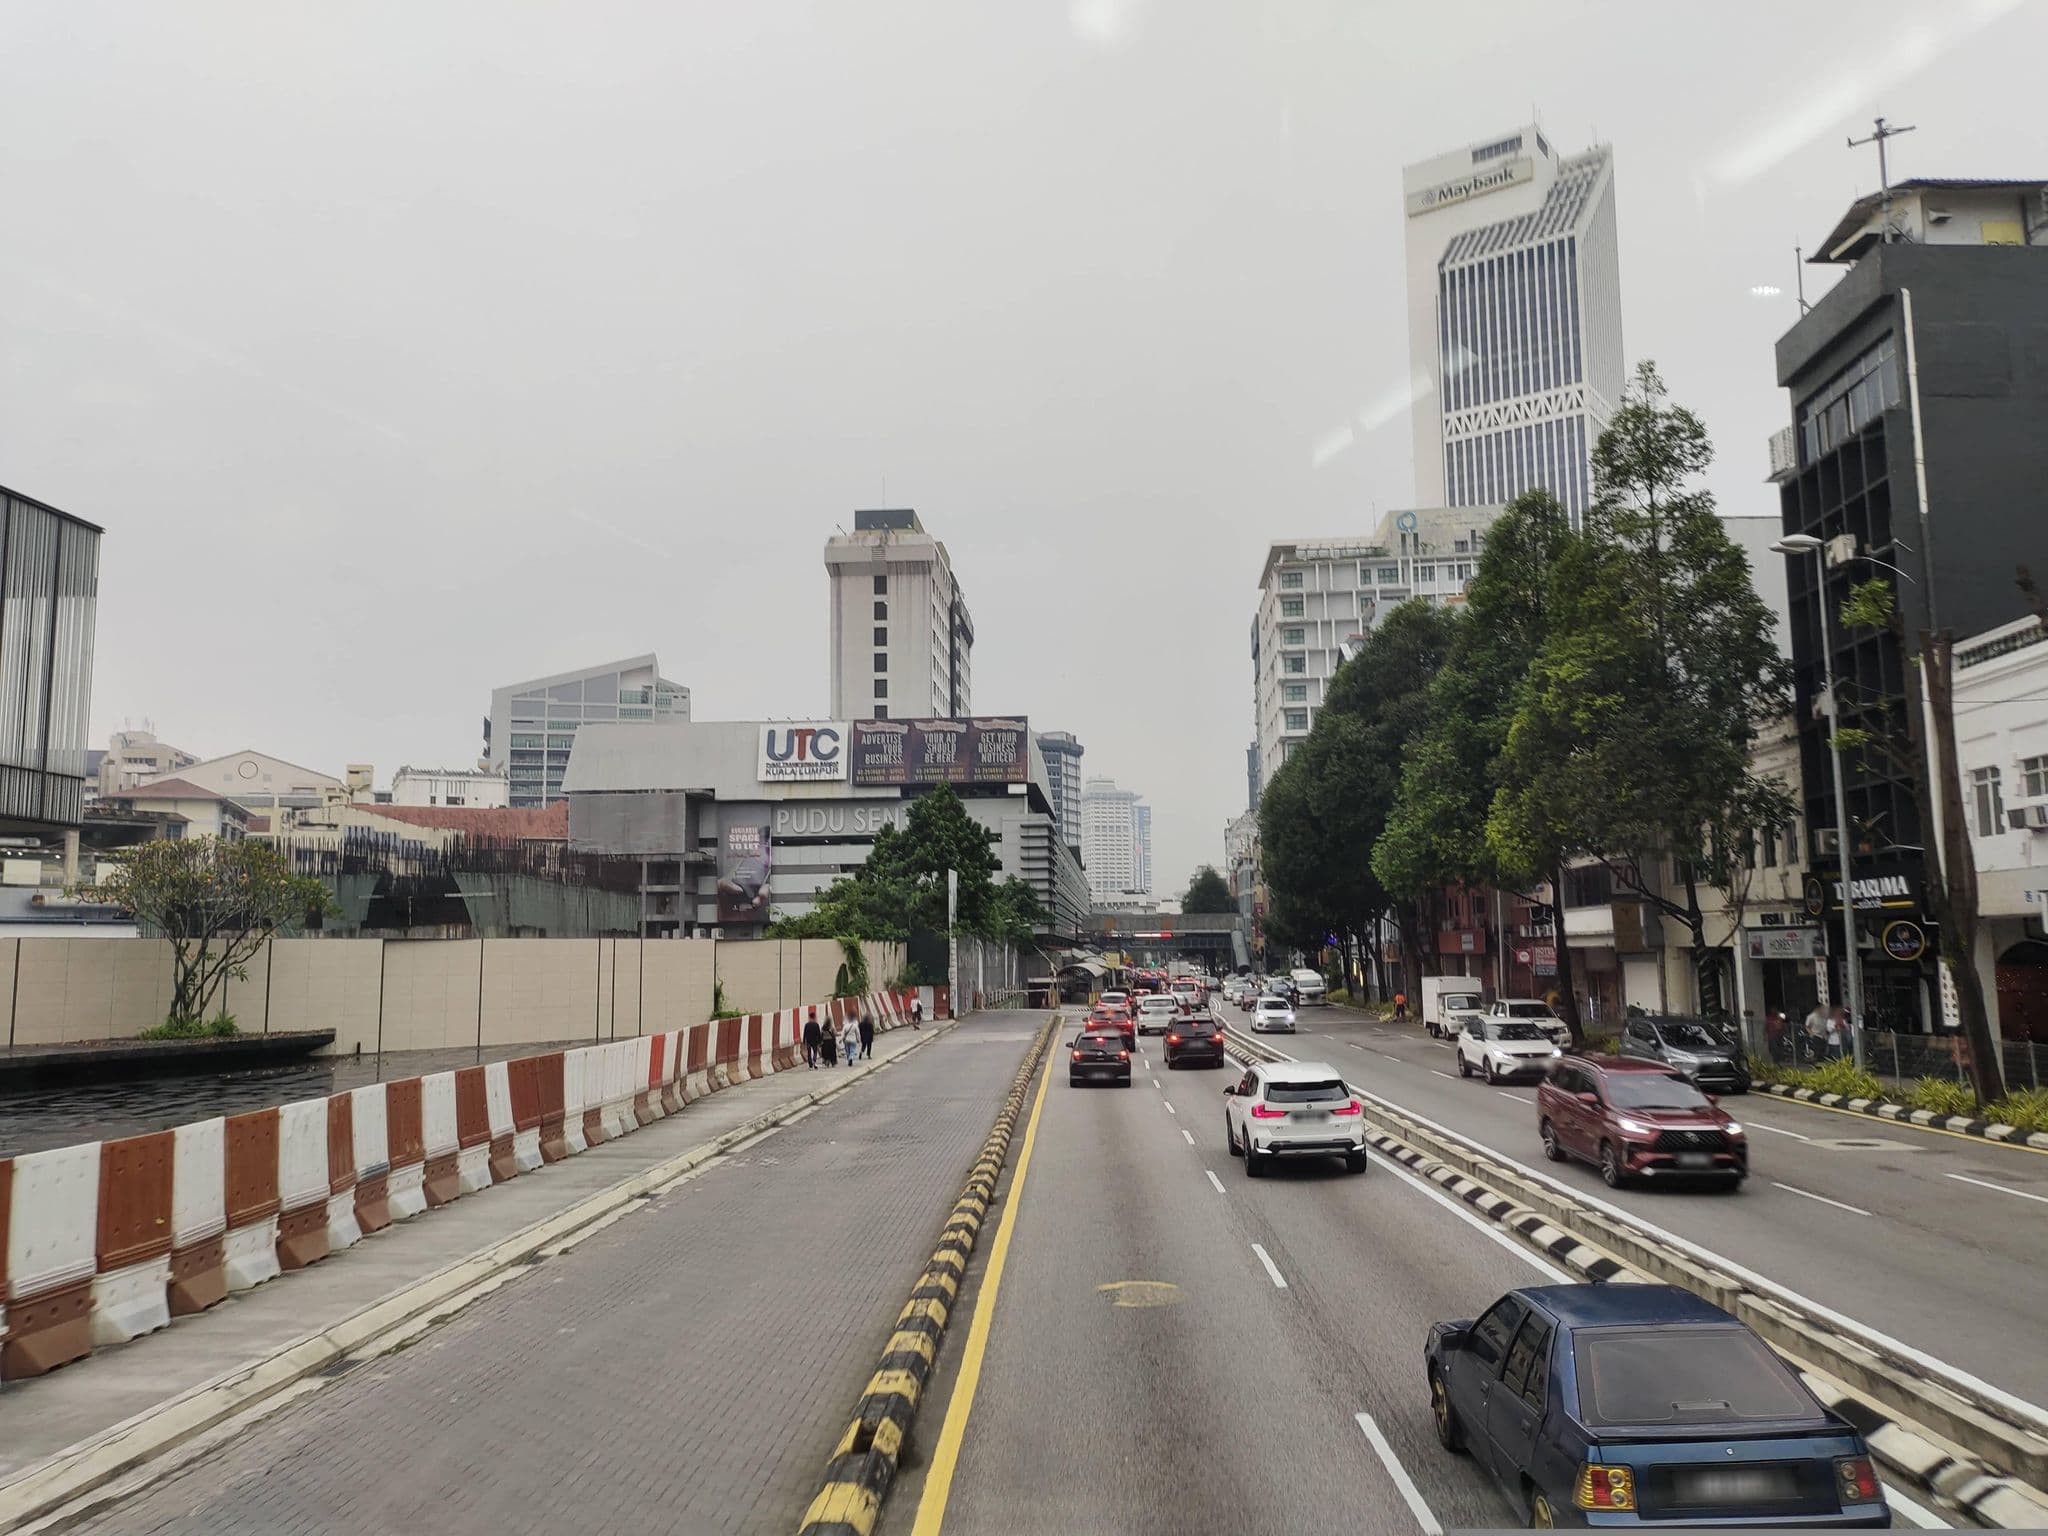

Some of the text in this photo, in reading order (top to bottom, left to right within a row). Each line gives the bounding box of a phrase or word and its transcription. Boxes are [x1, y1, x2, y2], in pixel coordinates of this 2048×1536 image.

[1438, 167, 1515, 202] Maybank
[861, 733, 903, 745] ADVERTISE
[924, 732, 957, 744] YOUR AD
[981, 731, 1017, 743] GET YOUR
[766, 728, 840, 761] UTC
[883, 744, 903, 755] YOUR
[926, 743, 957, 754] SHOULD
[978, 742, 1016, 753] BUSINESS
[924, 753, 934, 764] BE
[766, 765, 840, 777] KUALA LUMPUR
[776, 806, 845, 833] PUDU
[729, 834, 760, 842] SPACE
[729, 842, 760, 851] TO LET
